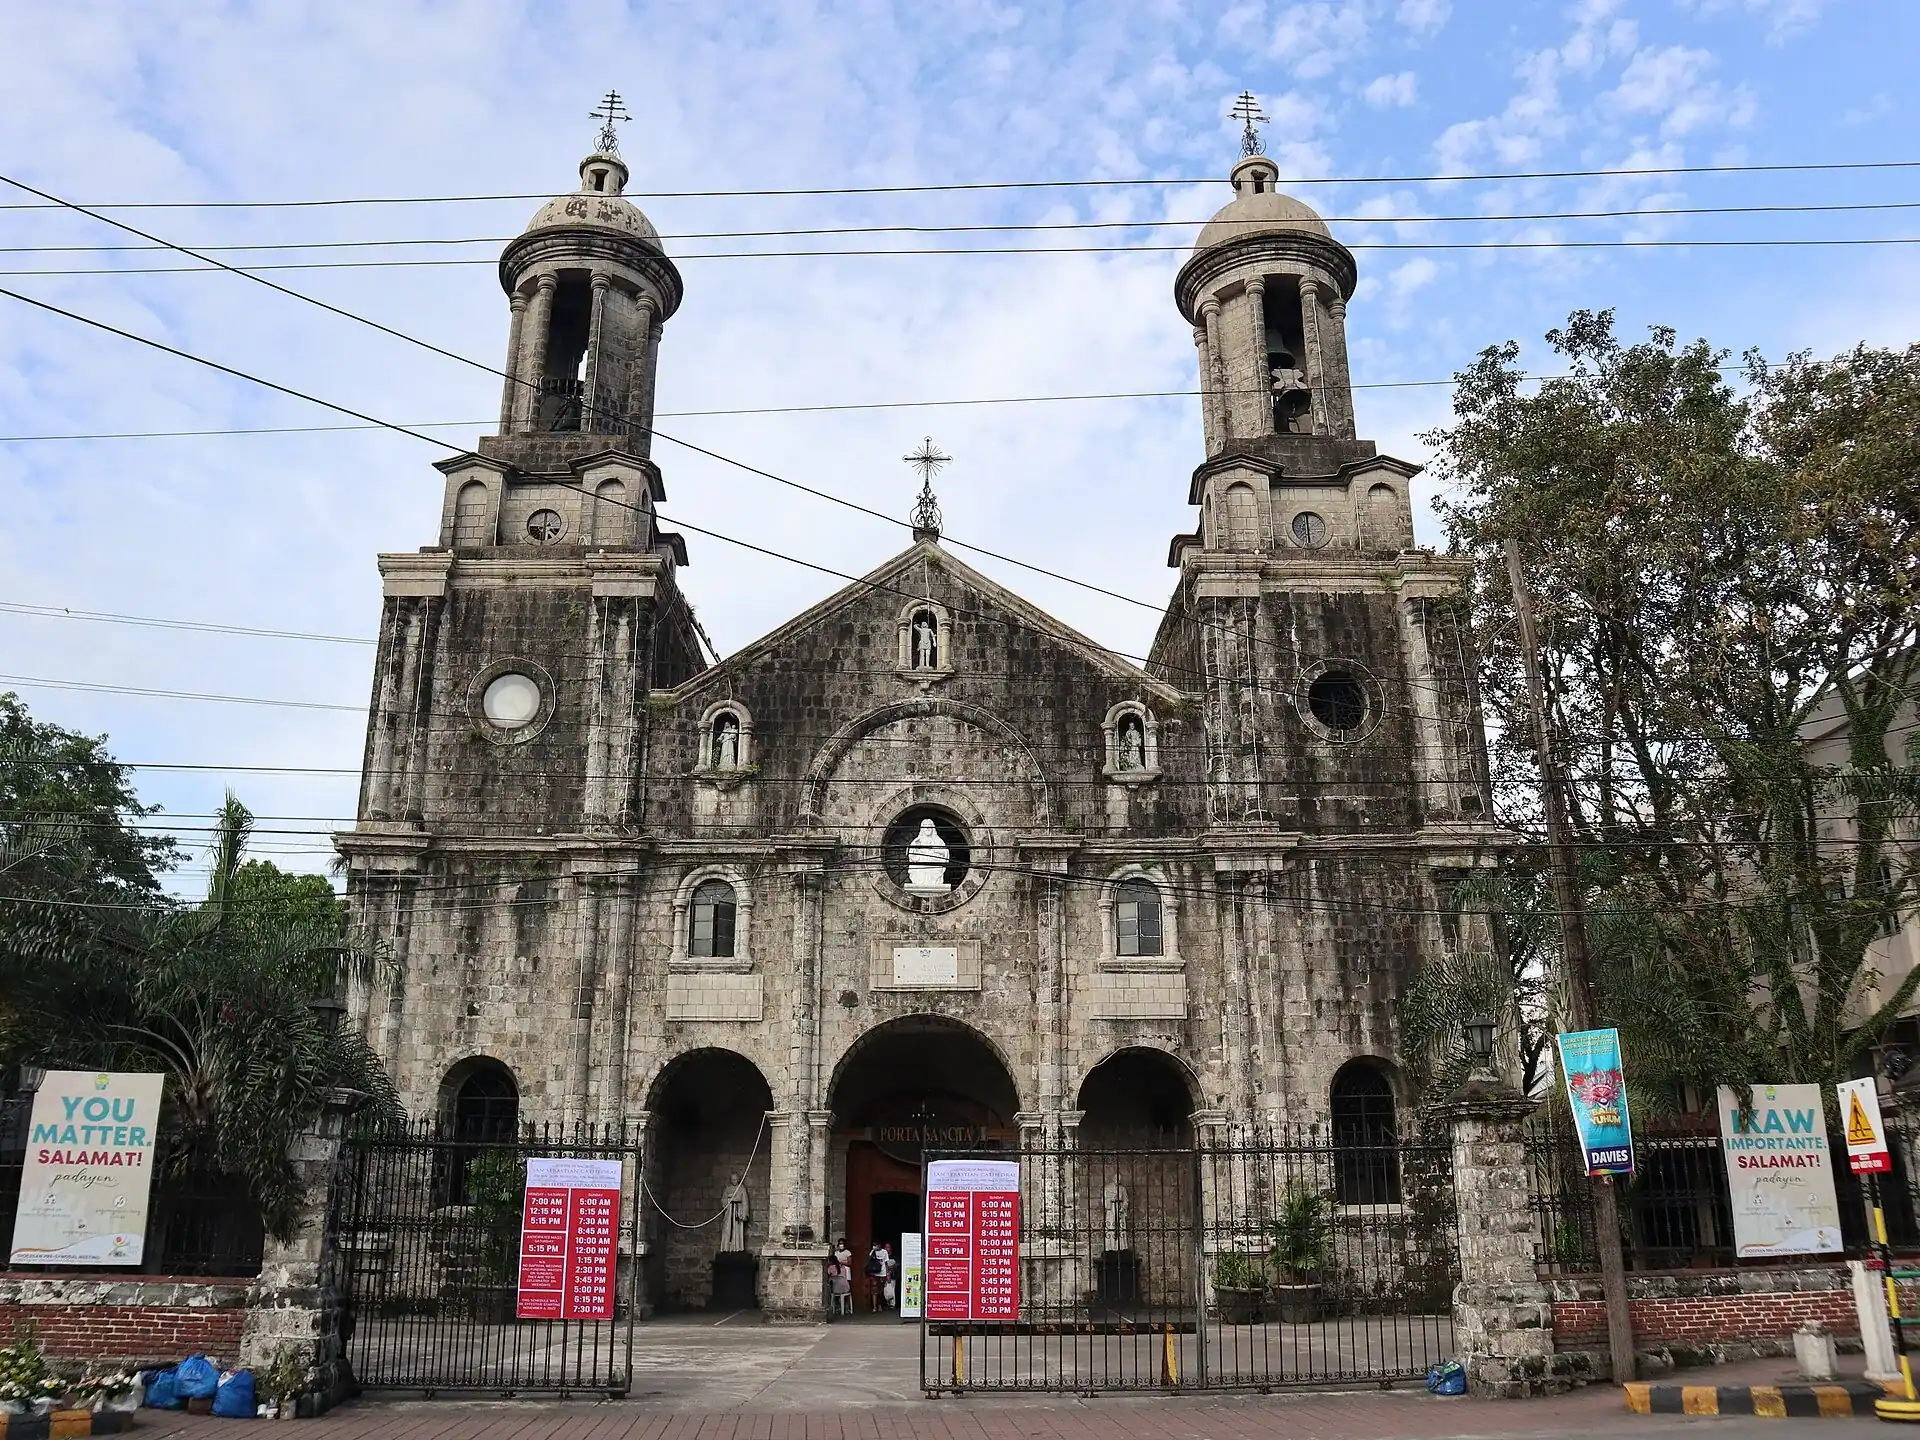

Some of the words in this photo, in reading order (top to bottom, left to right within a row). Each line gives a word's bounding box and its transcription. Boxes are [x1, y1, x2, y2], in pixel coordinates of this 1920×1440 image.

[61, 1096, 135, 1122] YOU
[1589, 1115, 1621, 1125] YUHUM
[1731, 1109, 1815, 1134] IKAW
[32, 1123, 152, 1147] MATTER.
[880, 1127, 920, 1141] PORTA
[1726, 1137, 1827, 1150] IMPORTANTE.
[38, 1149, 142, 1166] SALAMAT!
[1591, 1150, 1628, 1164] DAVIES
[1738, 1154, 1821, 1169] SALAMAT!
